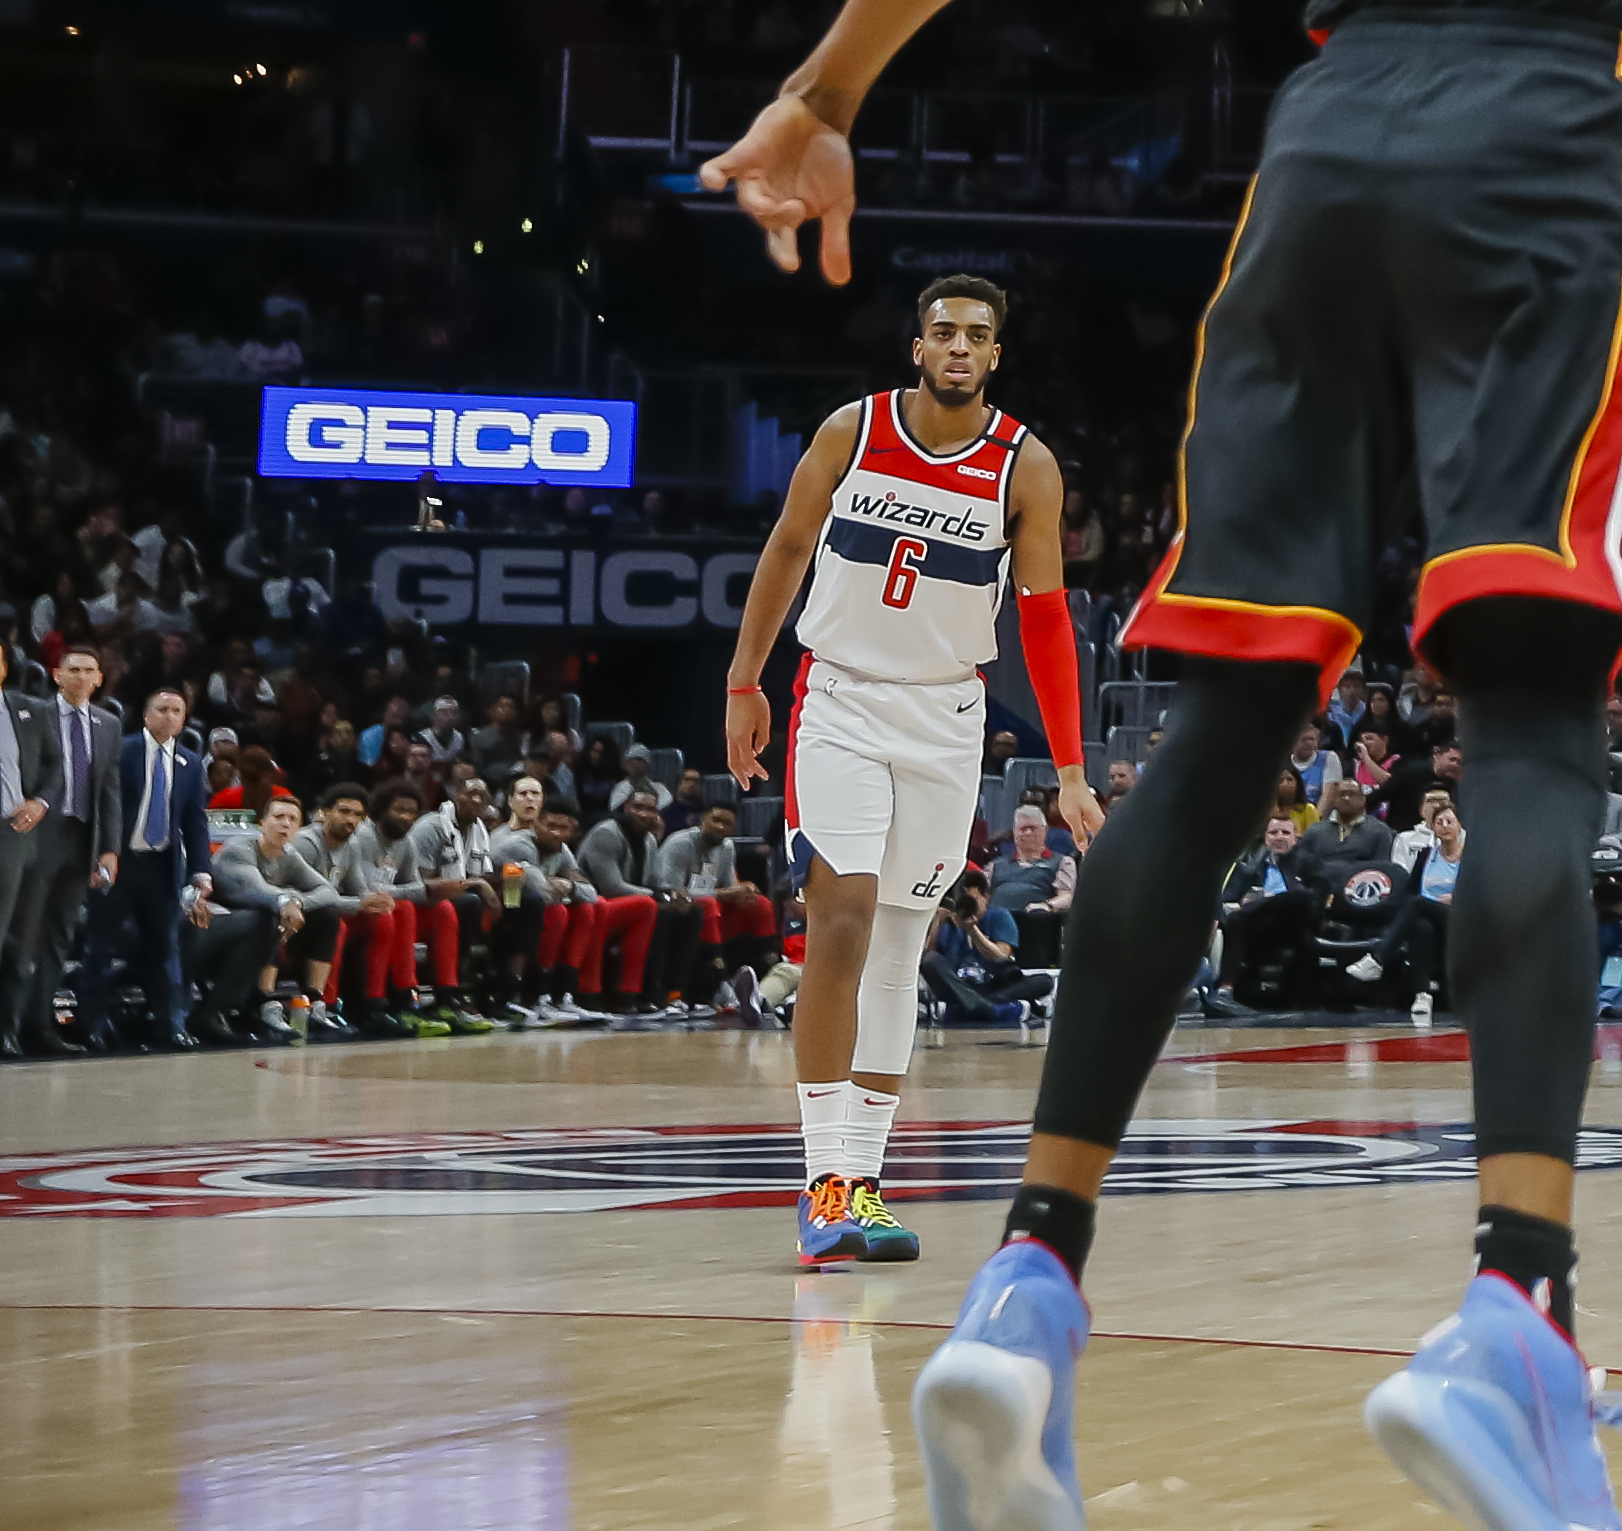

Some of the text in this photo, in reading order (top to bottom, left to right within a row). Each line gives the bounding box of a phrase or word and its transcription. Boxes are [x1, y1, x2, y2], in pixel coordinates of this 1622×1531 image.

[285, 400, 611, 472] GEICO
[850, 491, 991, 542] wizards
[882, 536, 928, 611] 6
